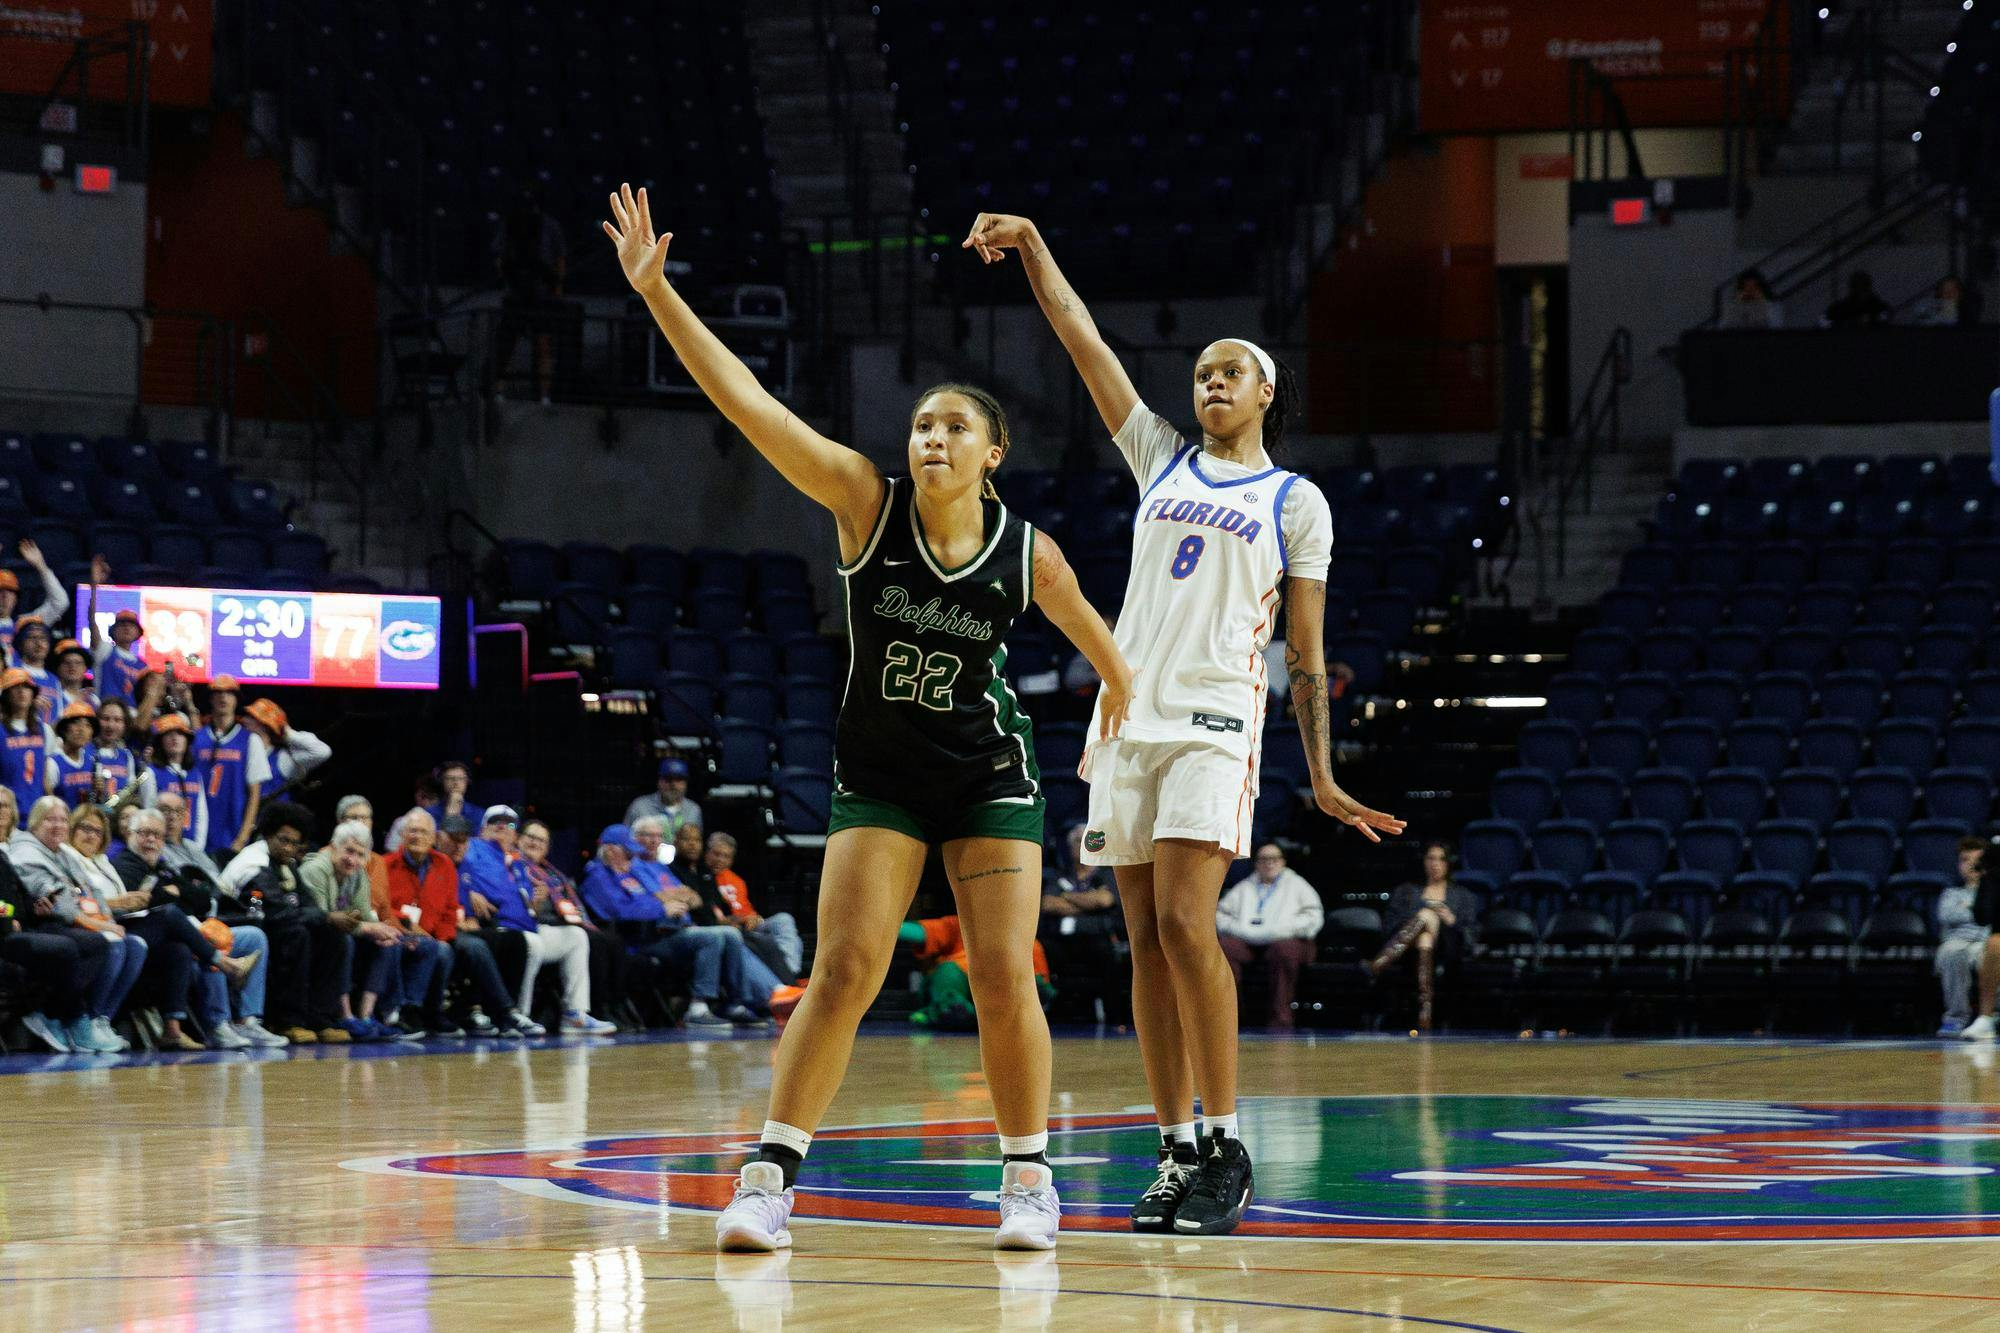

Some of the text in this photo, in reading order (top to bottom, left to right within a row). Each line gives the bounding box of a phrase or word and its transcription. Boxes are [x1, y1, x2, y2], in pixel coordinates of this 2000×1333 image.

[1144, 498, 1263, 545] FLORIDA
[1170, 533, 1206, 580] 8
[149, 610, 205, 654] 33
[217, 598, 305, 638] 2:30
[873, 585, 993, 641] Dolphins
[318, 616, 373, 659] 77
[882, 640, 963, 711] 22
